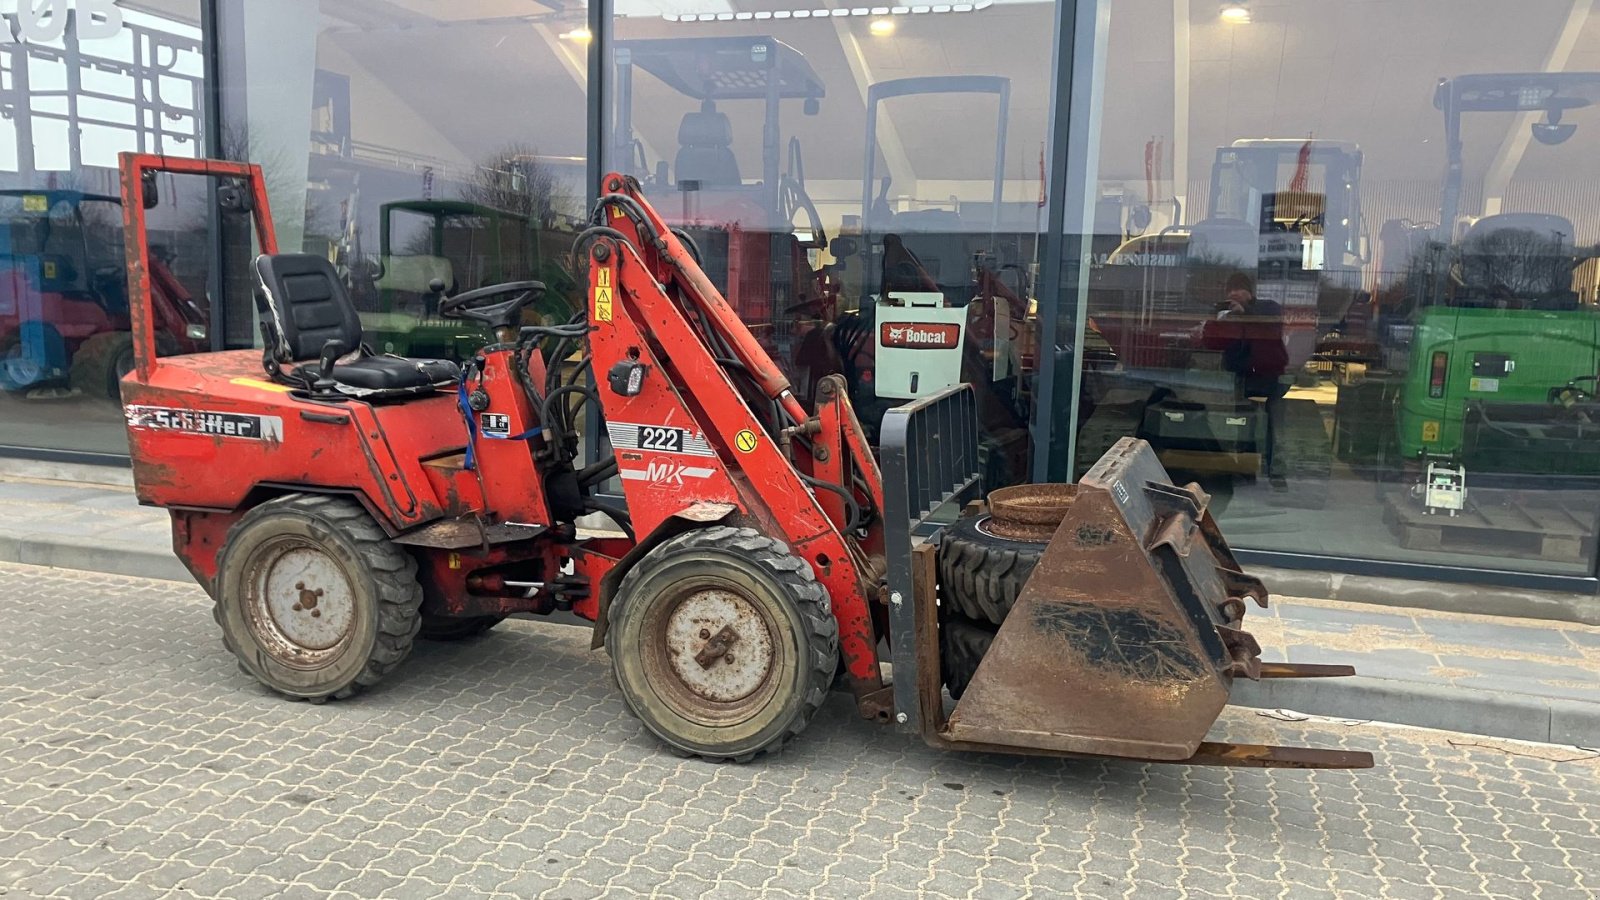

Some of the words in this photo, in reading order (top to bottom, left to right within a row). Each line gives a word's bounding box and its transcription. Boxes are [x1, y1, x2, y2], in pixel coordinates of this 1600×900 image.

[0, 0, 123, 43] ØB
[905, 329, 946, 344] Bobcat
[642, 427, 678, 451] 222
[645, 462, 684, 485] MK
